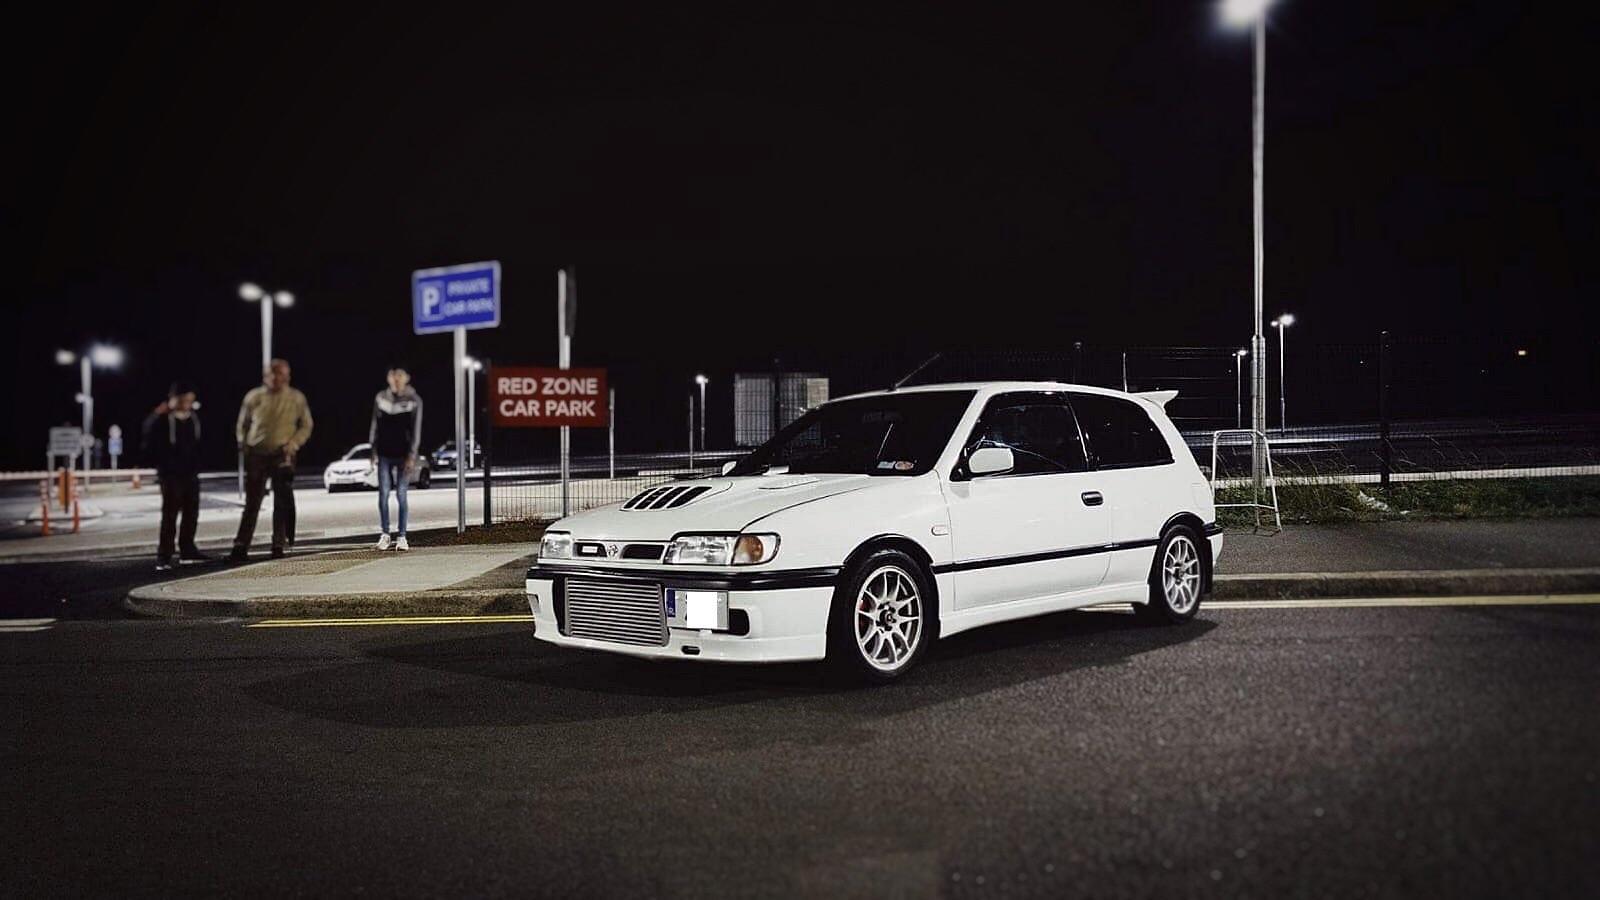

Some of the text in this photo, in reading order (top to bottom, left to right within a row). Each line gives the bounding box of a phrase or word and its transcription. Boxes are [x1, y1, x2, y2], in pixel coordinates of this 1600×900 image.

[422, 286, 440, 317] P
[444, 301, 465, 316] CAR
[498, 377, 599, 395] RED ZONE
[499, 399, 596, 417] CAR PARK
